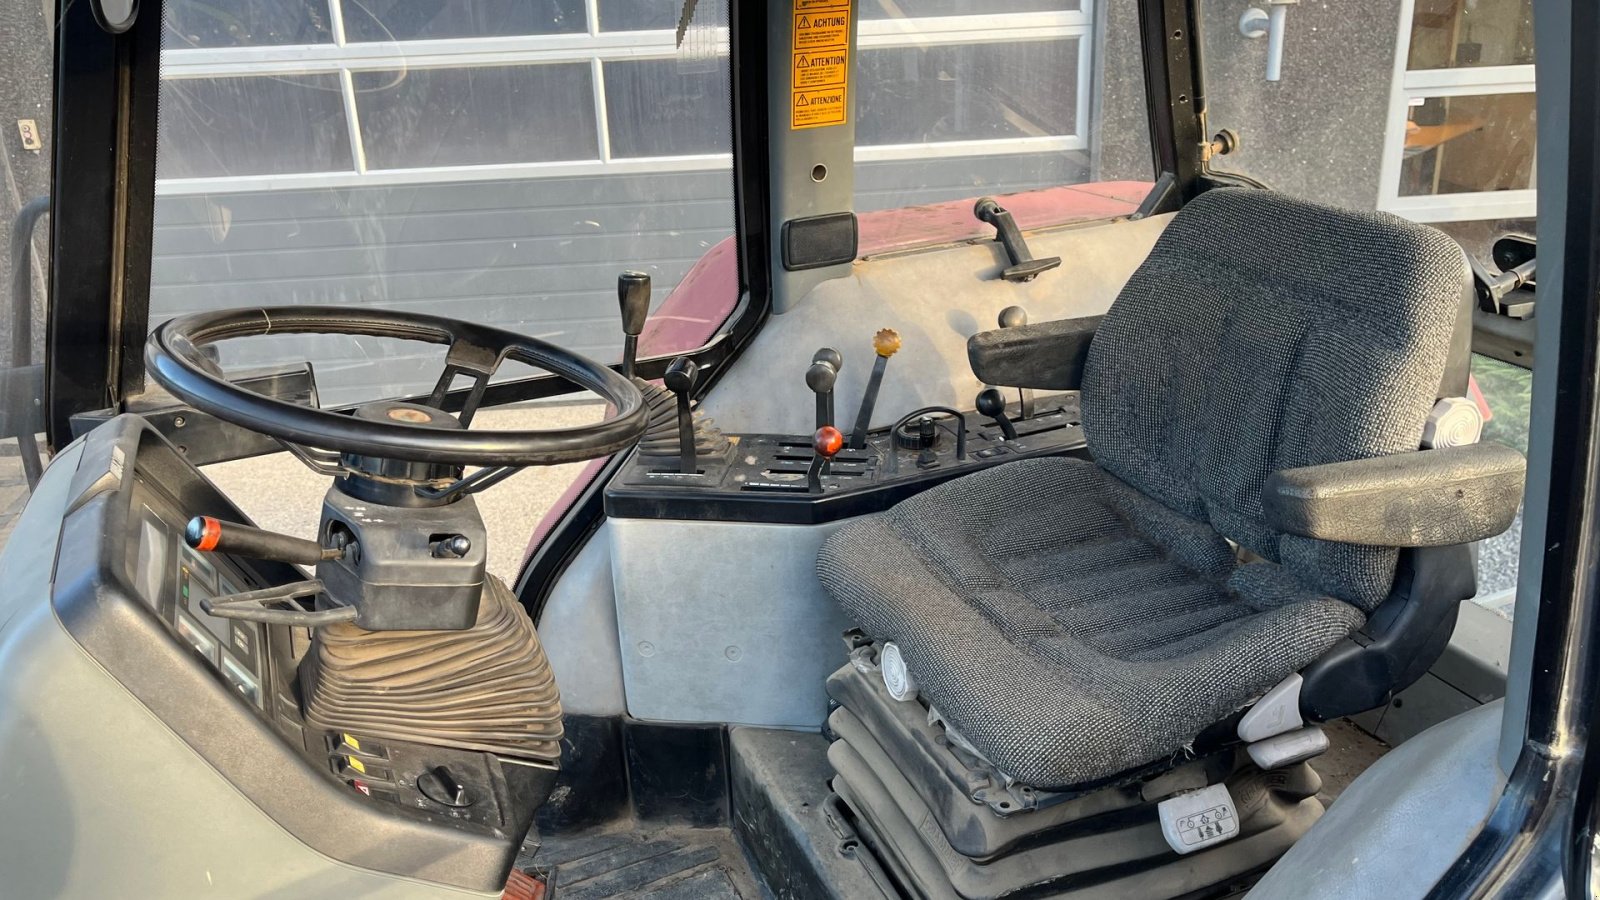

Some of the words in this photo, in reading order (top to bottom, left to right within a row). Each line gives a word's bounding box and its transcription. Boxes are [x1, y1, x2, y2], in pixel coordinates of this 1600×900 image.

[813, 17, 845, 28] ACHTUNG
[811, 56, 845, 67] ATTENTION
[811, 95, 842, 105] ATTENZIONE
